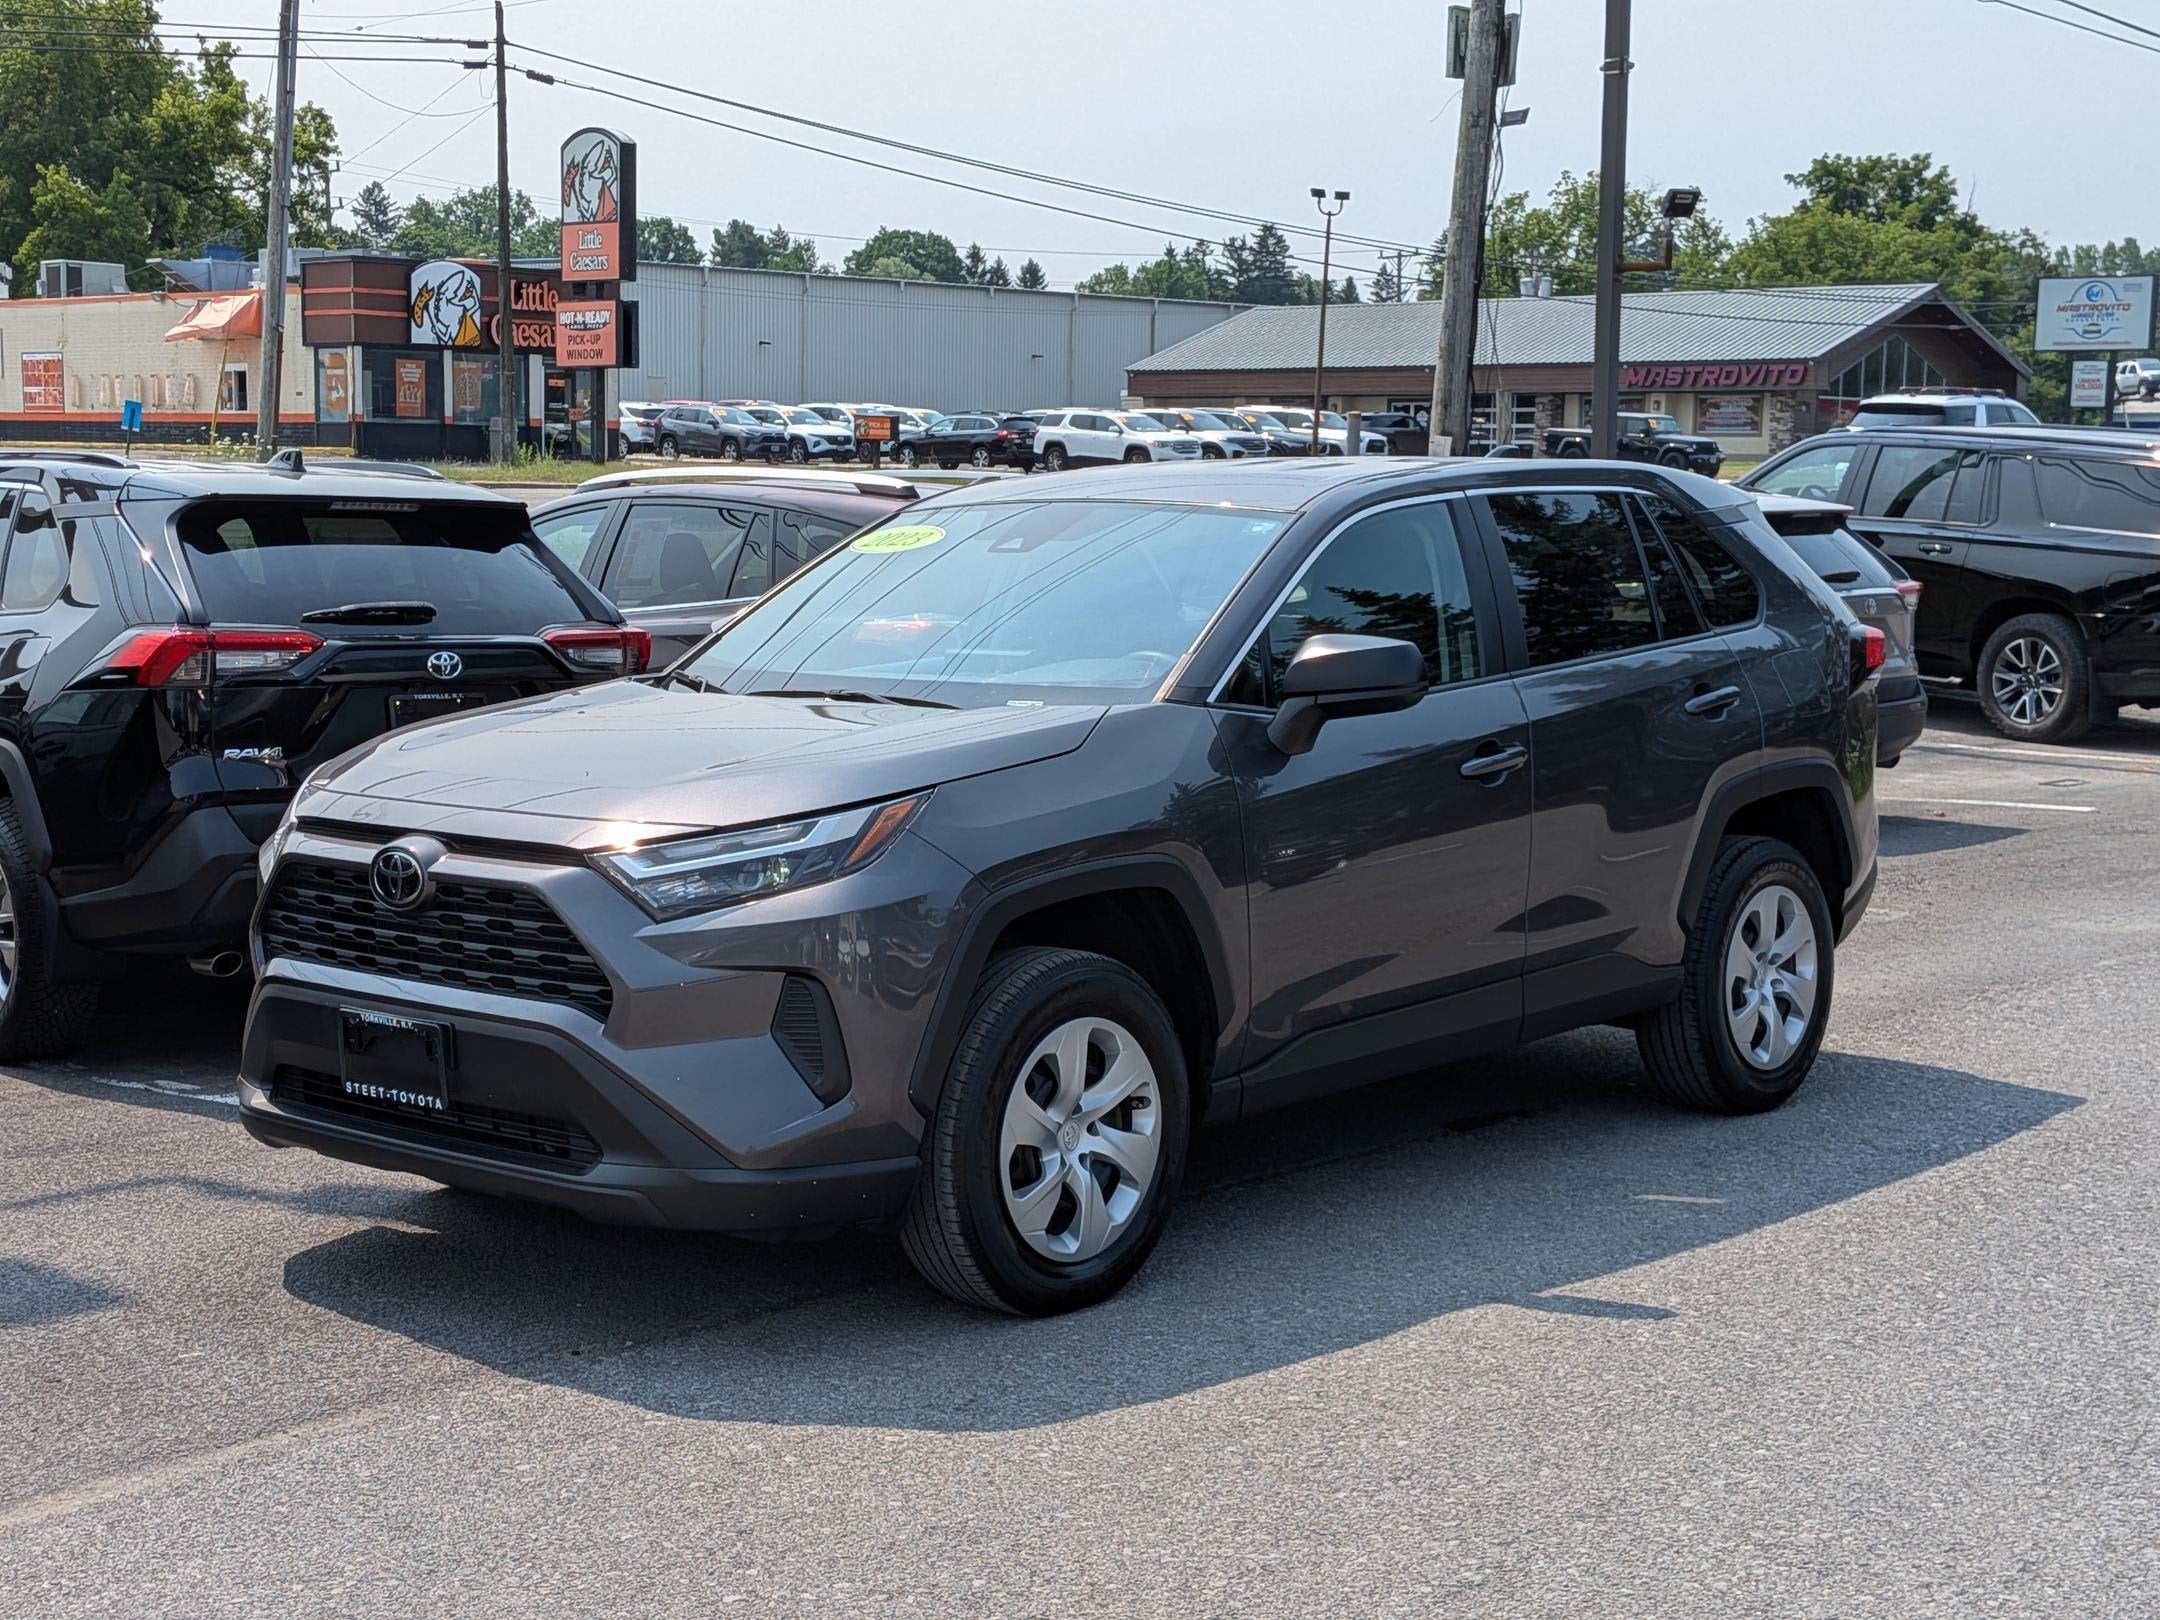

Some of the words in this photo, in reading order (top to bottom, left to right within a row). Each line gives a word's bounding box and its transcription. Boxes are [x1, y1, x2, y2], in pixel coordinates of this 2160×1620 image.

[578, 230, 602, 249] Little
[570, 252, 608, 271] Caesars
[510, 279, 559, 312] Little
[2056, 303, 2131, 312] MASTROVITO
[560, 310, 611, 325] HOT-N-READY
[567, 334, 602, 346] PICK-UP
[566, 348, 604, 360] WINDOW
[1625, 364, 1808, 388] MASTROVITO
[859, 531, 935, 547] 2023
[222, 747, 283, 760] RAV4
